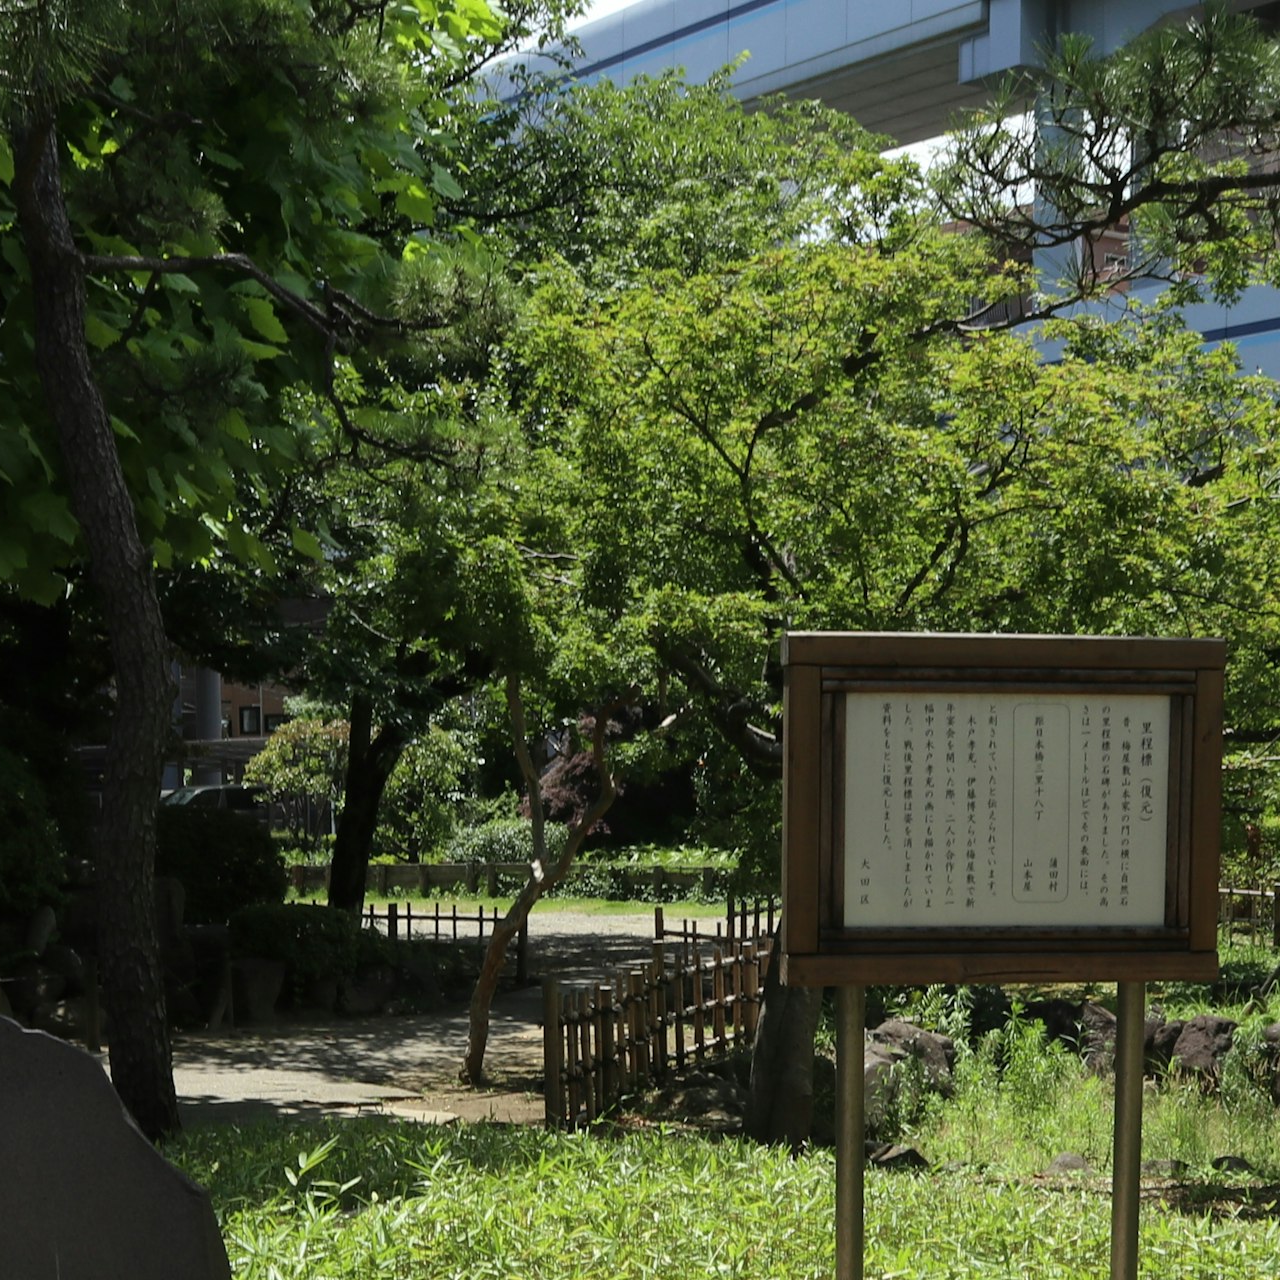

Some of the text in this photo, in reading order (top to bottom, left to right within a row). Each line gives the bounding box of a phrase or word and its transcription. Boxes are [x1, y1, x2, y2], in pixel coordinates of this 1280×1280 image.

[882, 702, 893, 851] 資料をもとに復元しました。
[860, 858, 871, 905] 大田区
[1022, 857, 1033, 892] 山本屋
